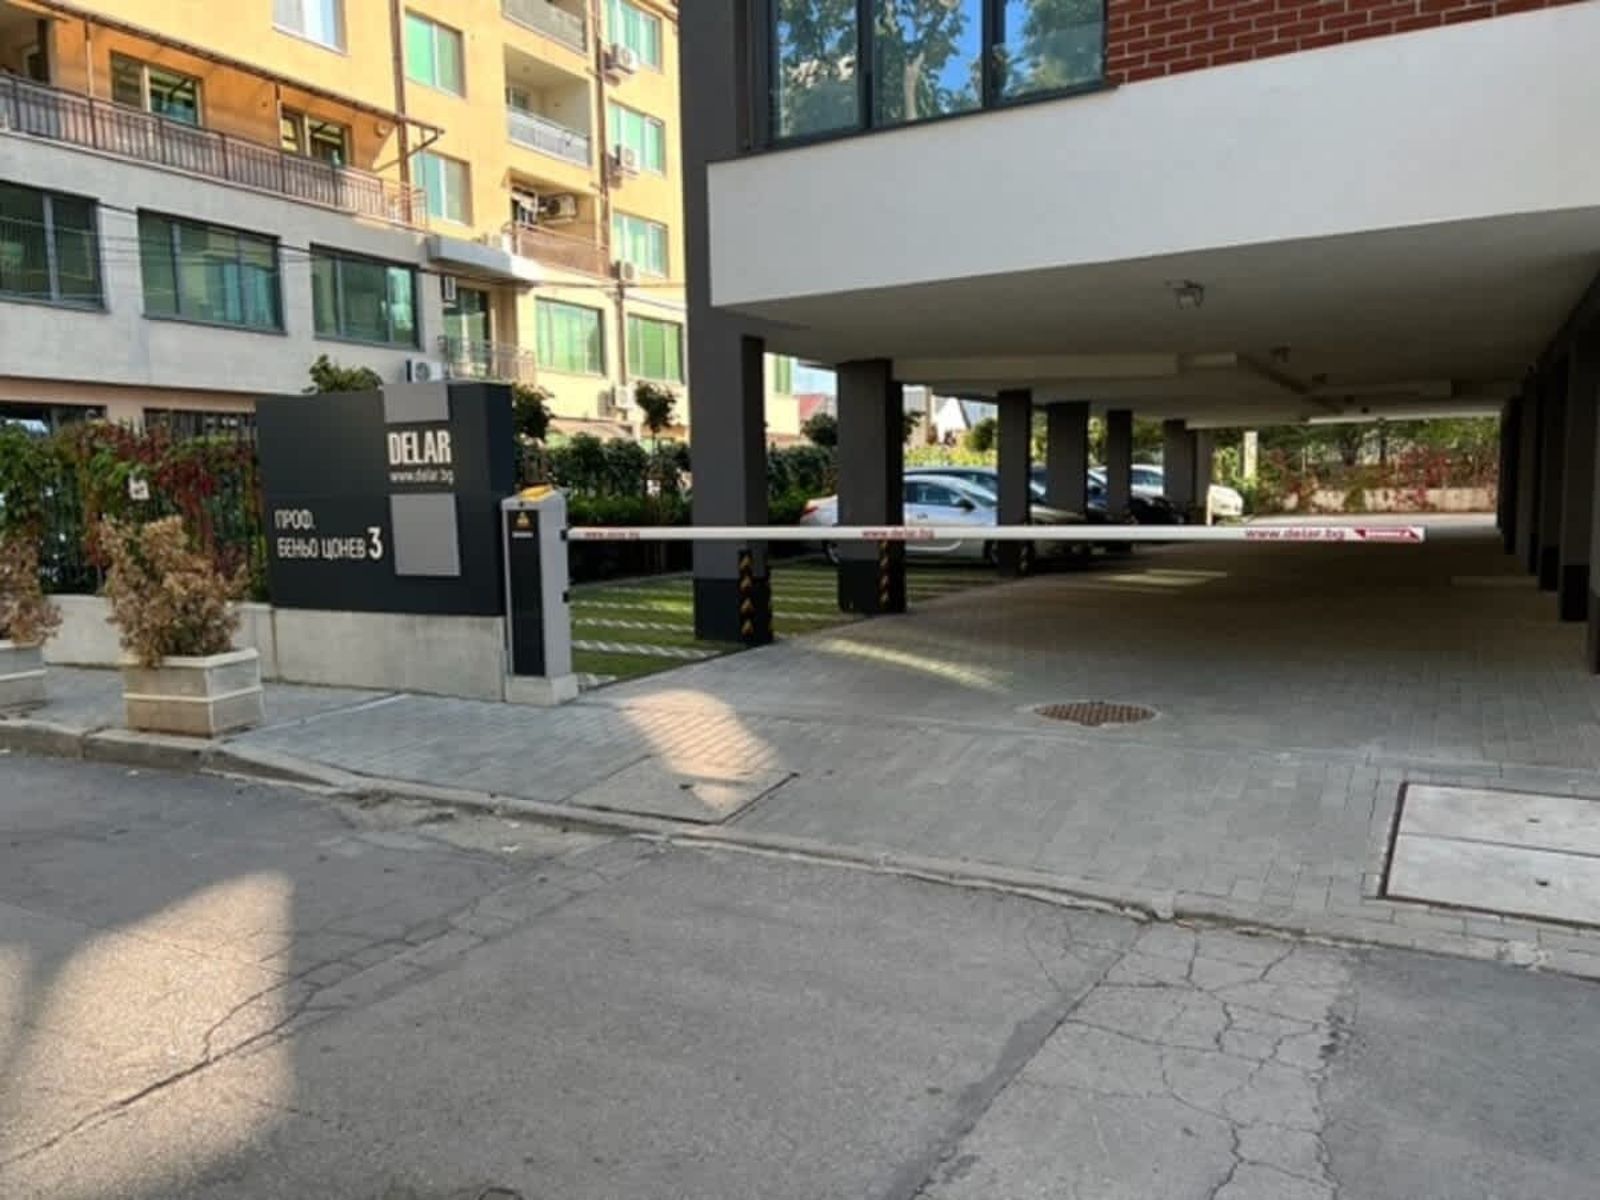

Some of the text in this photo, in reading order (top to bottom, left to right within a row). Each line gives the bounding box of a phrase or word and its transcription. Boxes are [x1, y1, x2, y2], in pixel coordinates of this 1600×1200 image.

[388, 430, 452, 465] DELAR
[390, 467, 454, 486] www.delar.bg
[274, 509, 317, 530] ПРОФ.
[277, 526, 384, 560] БЕНЬО ЦОНЕВ 3
